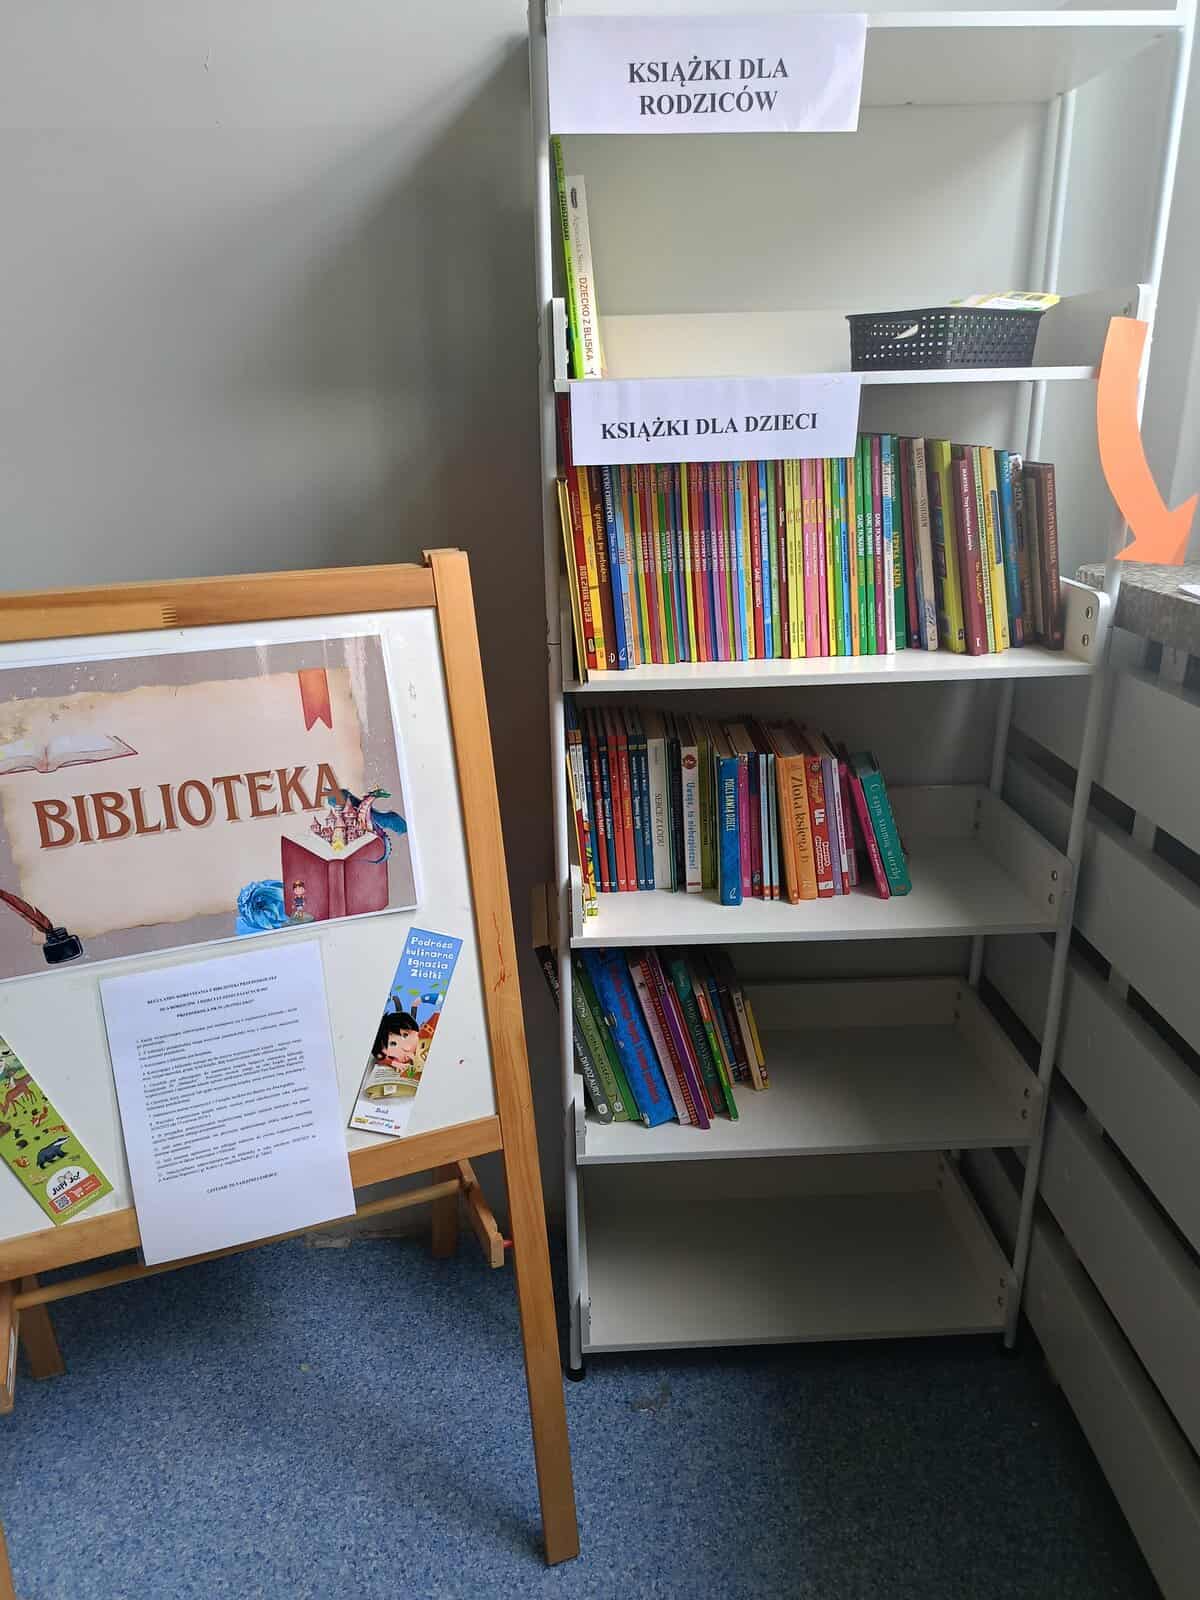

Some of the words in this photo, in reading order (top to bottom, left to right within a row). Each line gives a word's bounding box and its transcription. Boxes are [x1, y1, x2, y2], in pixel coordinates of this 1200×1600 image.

[628, 56, 731, 87] KSIĄŻKI
[739, 58, 788, 79] DLA
[639, 86, 778, 115] RODZICÓW
[579, 277, 589, 316] DZIECKO
[584, 326, 592, 360] BLISKA
[601, 417, 689, 441] KSIĄŻKI
[696, 417, 738, 434] DLA
[745, 412, 818, 433] DZIECI
[32, 763, 343, 849] BIBLIOTEKA
